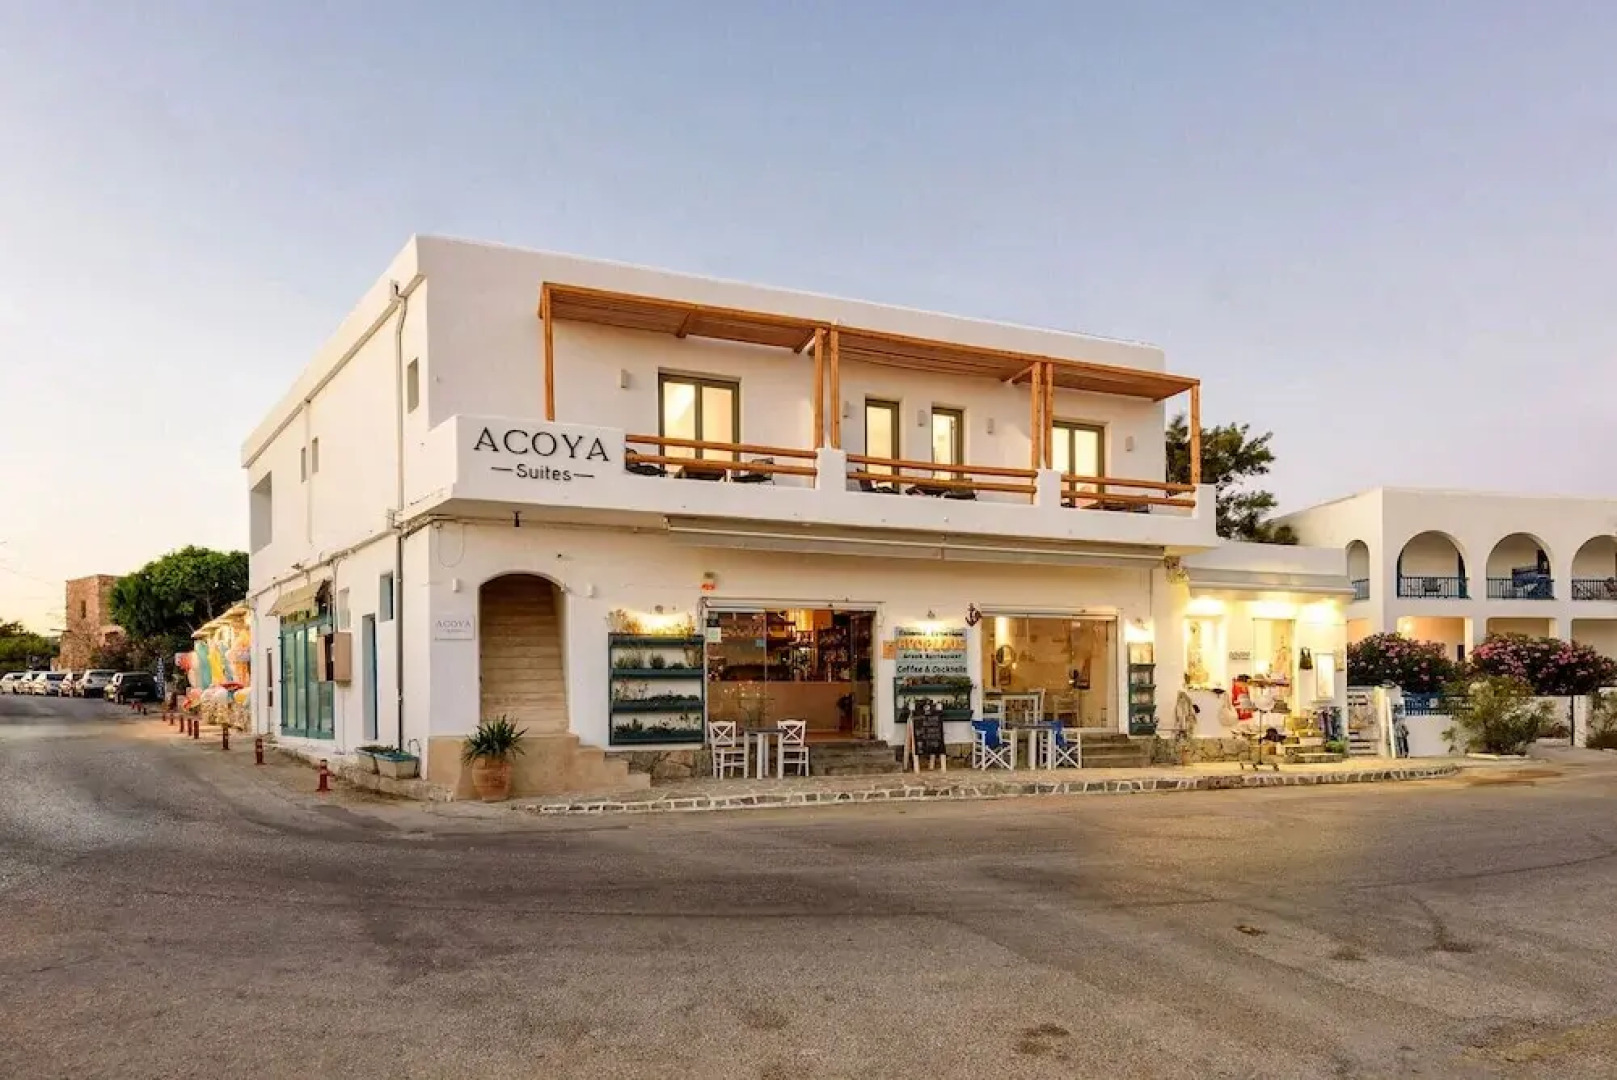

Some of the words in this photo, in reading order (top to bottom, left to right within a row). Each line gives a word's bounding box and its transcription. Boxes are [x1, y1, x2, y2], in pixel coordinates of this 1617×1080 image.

[473, 427, 610, 461] ACOYA
[516, 463, 572, 481] Suites
[897, 665, 922, 673] Coffee
[932, 665, 967, 673] Cocktails
